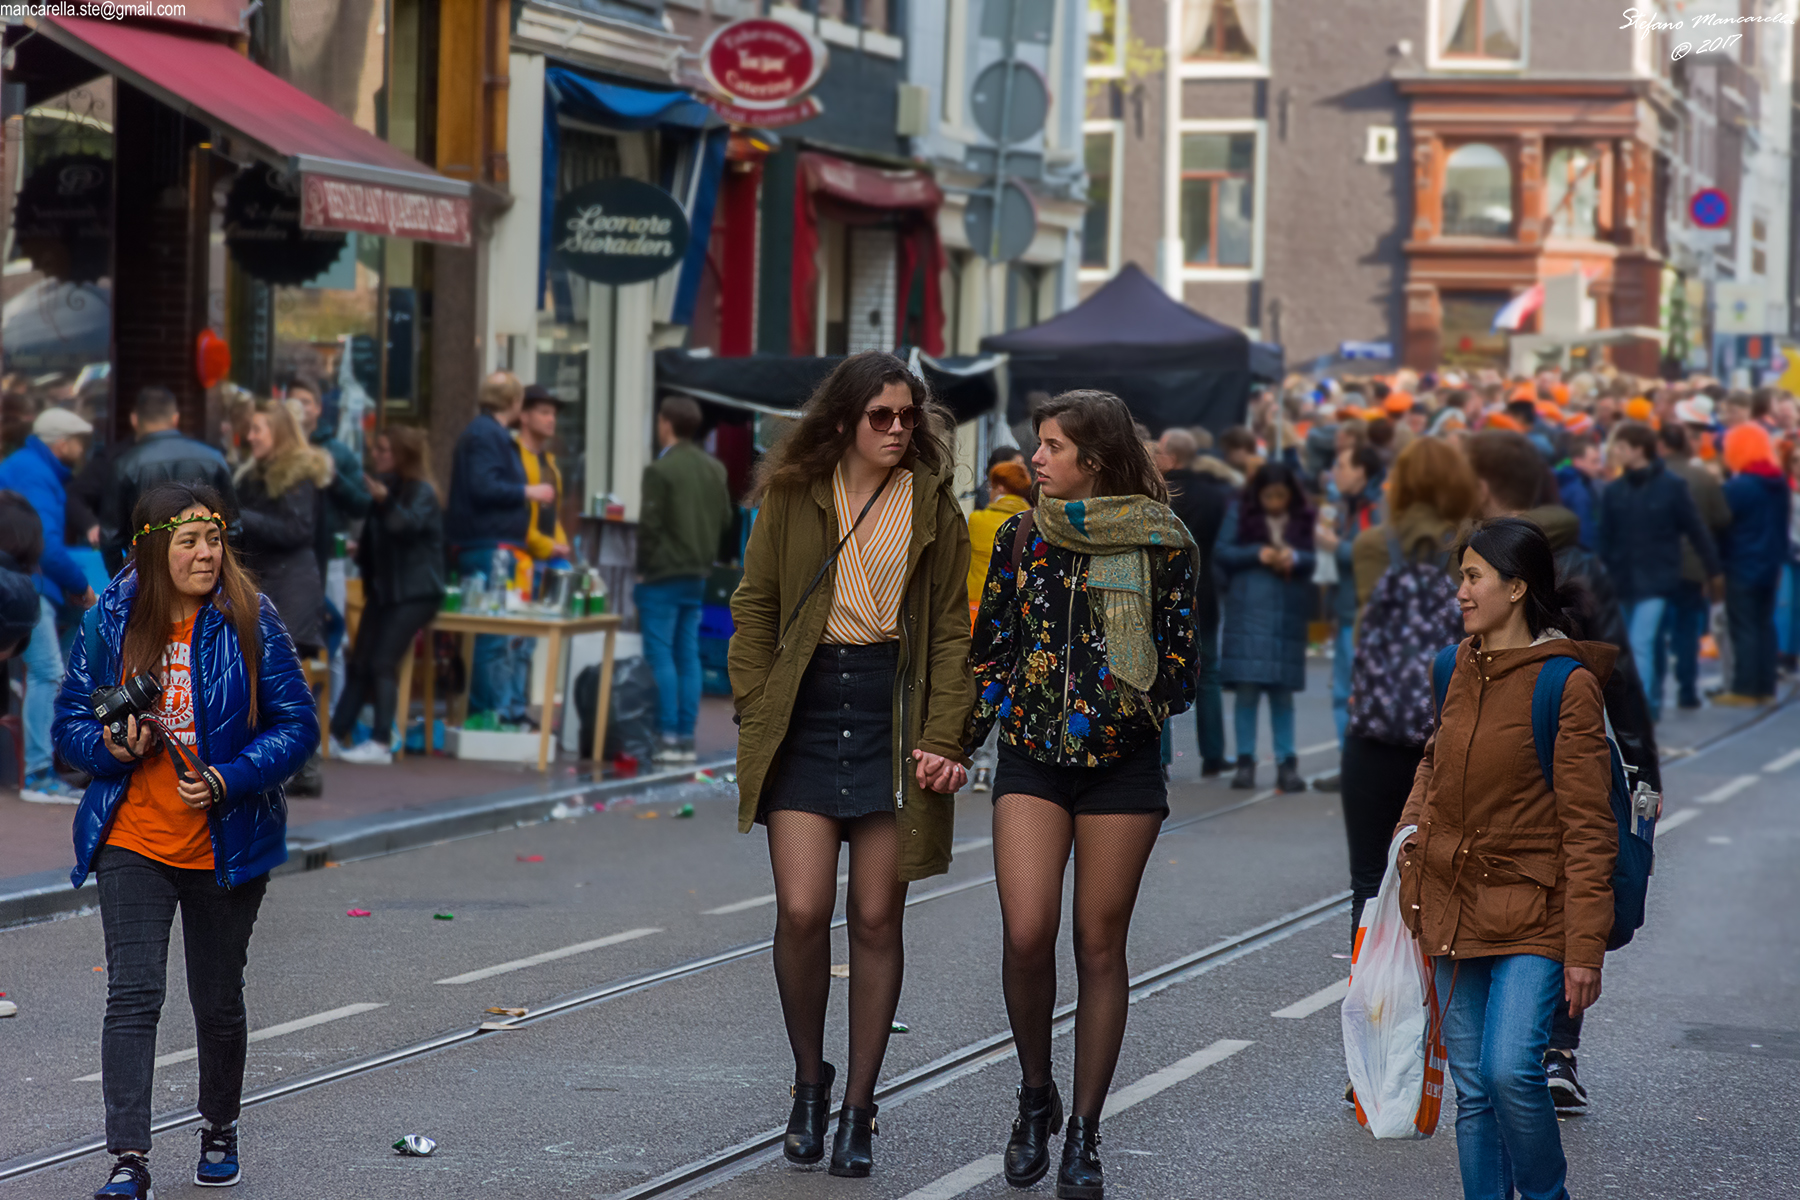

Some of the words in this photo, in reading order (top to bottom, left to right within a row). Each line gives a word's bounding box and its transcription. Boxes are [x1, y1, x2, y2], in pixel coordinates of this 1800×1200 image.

[725, 69, 794, 96] Catering
[566, 203, 672, 235] Leonore
[556, 228, 674, 257] Sieraden
[202, 770, 221, 803] Canon
